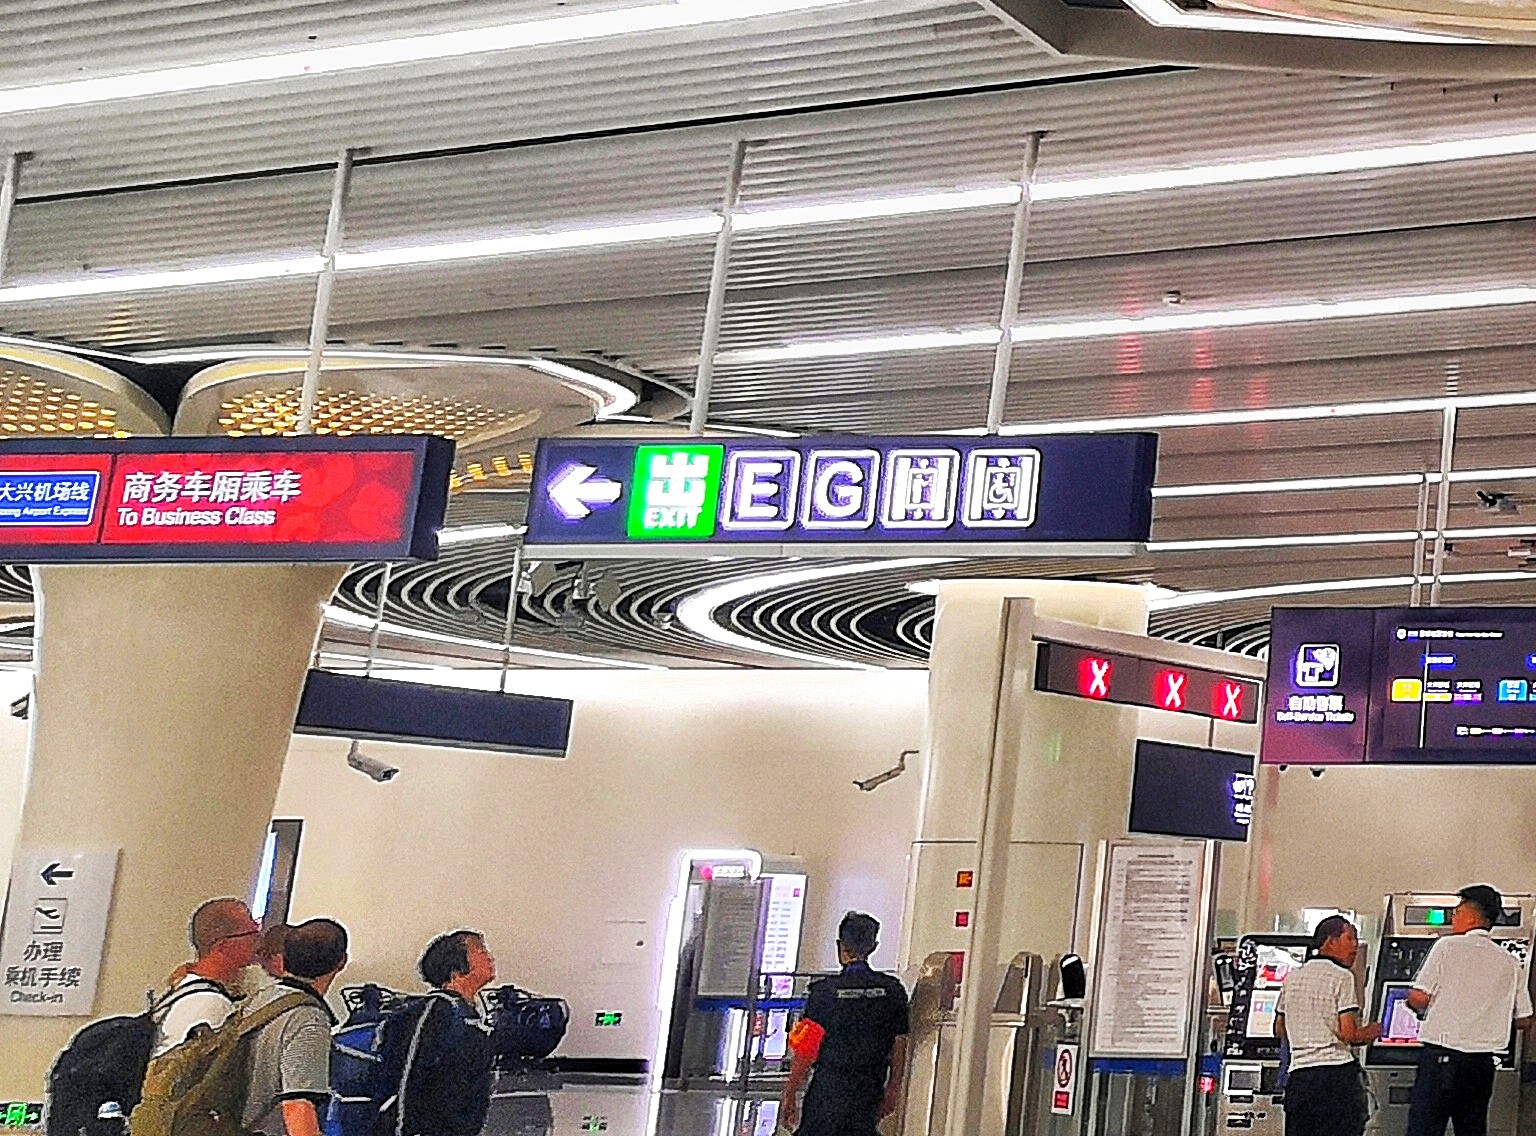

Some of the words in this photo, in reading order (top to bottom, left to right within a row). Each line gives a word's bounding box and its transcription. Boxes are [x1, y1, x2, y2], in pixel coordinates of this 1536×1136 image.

[122, 469, 301, 502] 商务车厢乘车
[647, 452, 710, 505] 出
[0, 480, 89, 501] 大兴机场线
[735, 462, 782, 518] E
[814, 461, 863, 517] G
[118, 507, 137, 526] To
[142, 507, 221, 525] Business
[224, 507, 275, 524] Class
[644, 507, 701, 528] EXIT
[23, 940, 63, 961] 办理
[5, 966, 81, 987] 乘机手续
